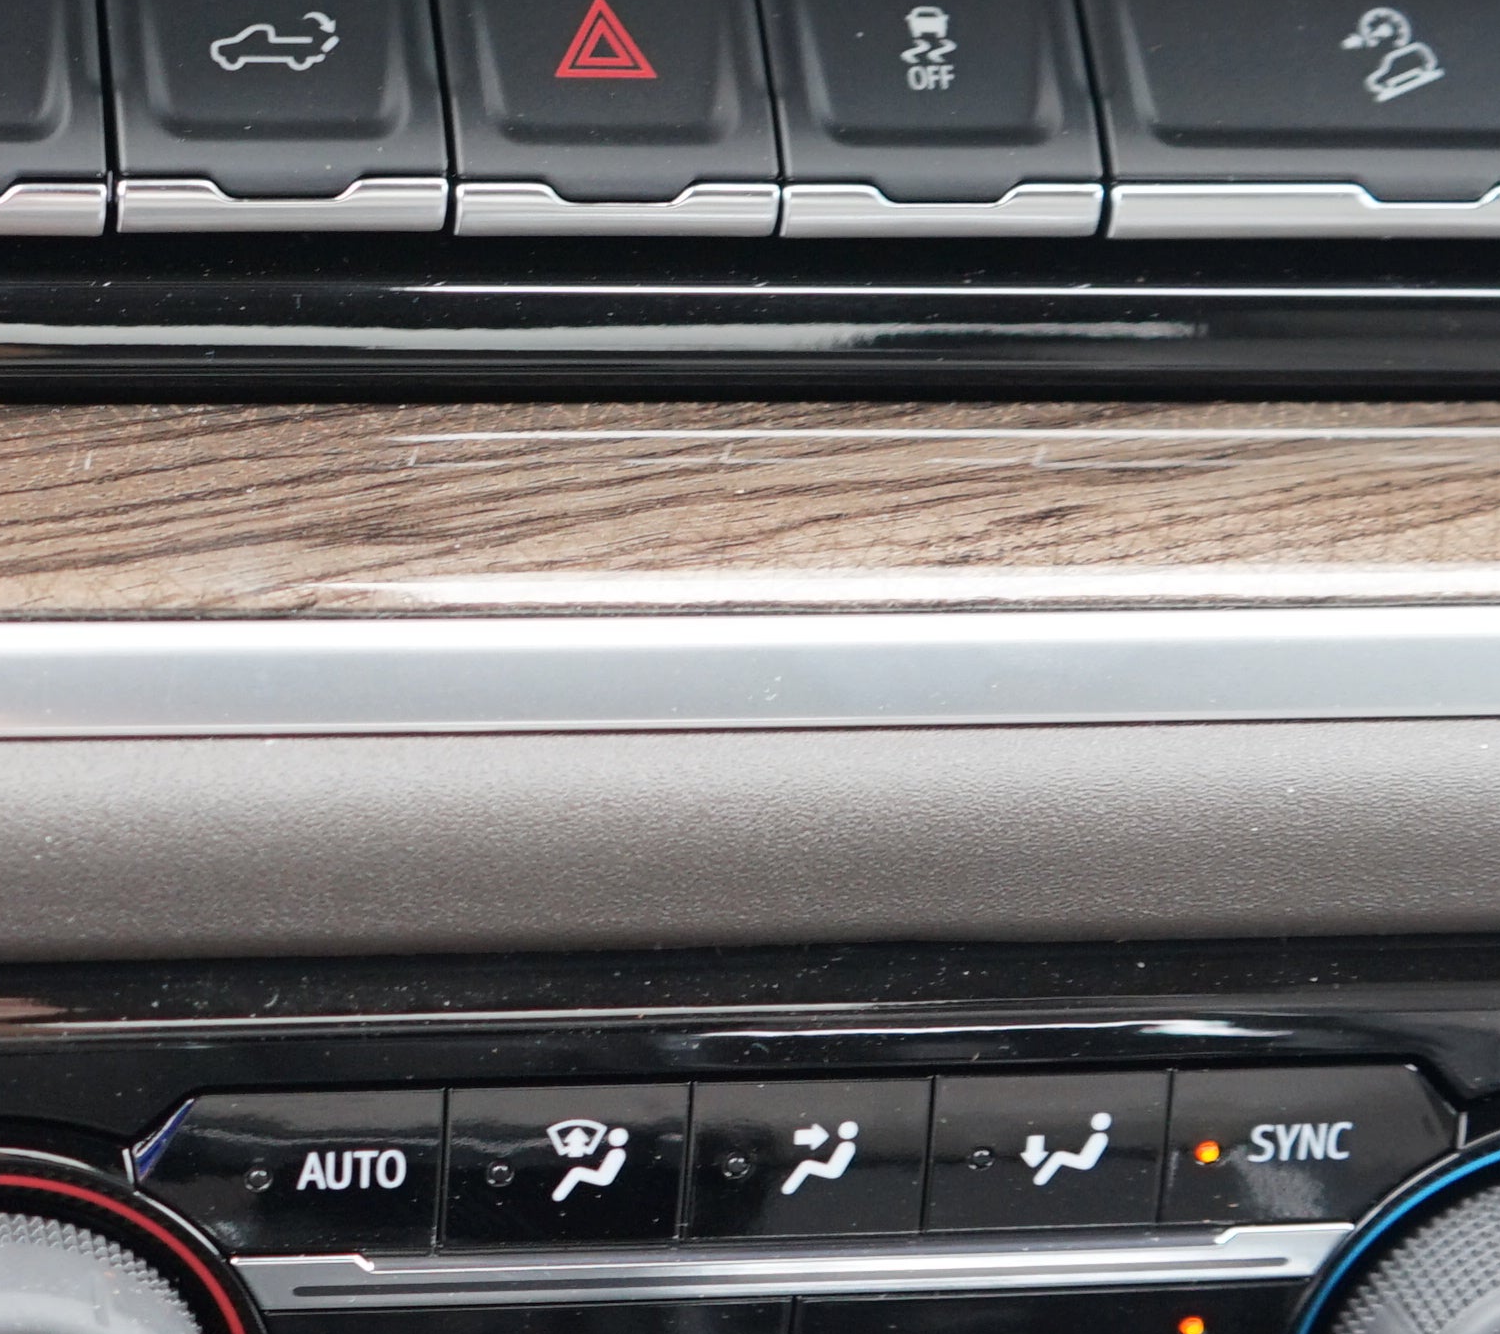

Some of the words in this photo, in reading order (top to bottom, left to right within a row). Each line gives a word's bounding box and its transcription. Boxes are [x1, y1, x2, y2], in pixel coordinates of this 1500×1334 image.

[906, 64, 955, 91] OFF
[1248, 1121, 1353, 1162] SYNC
[296, 1149, 407, 1190] AUTO
